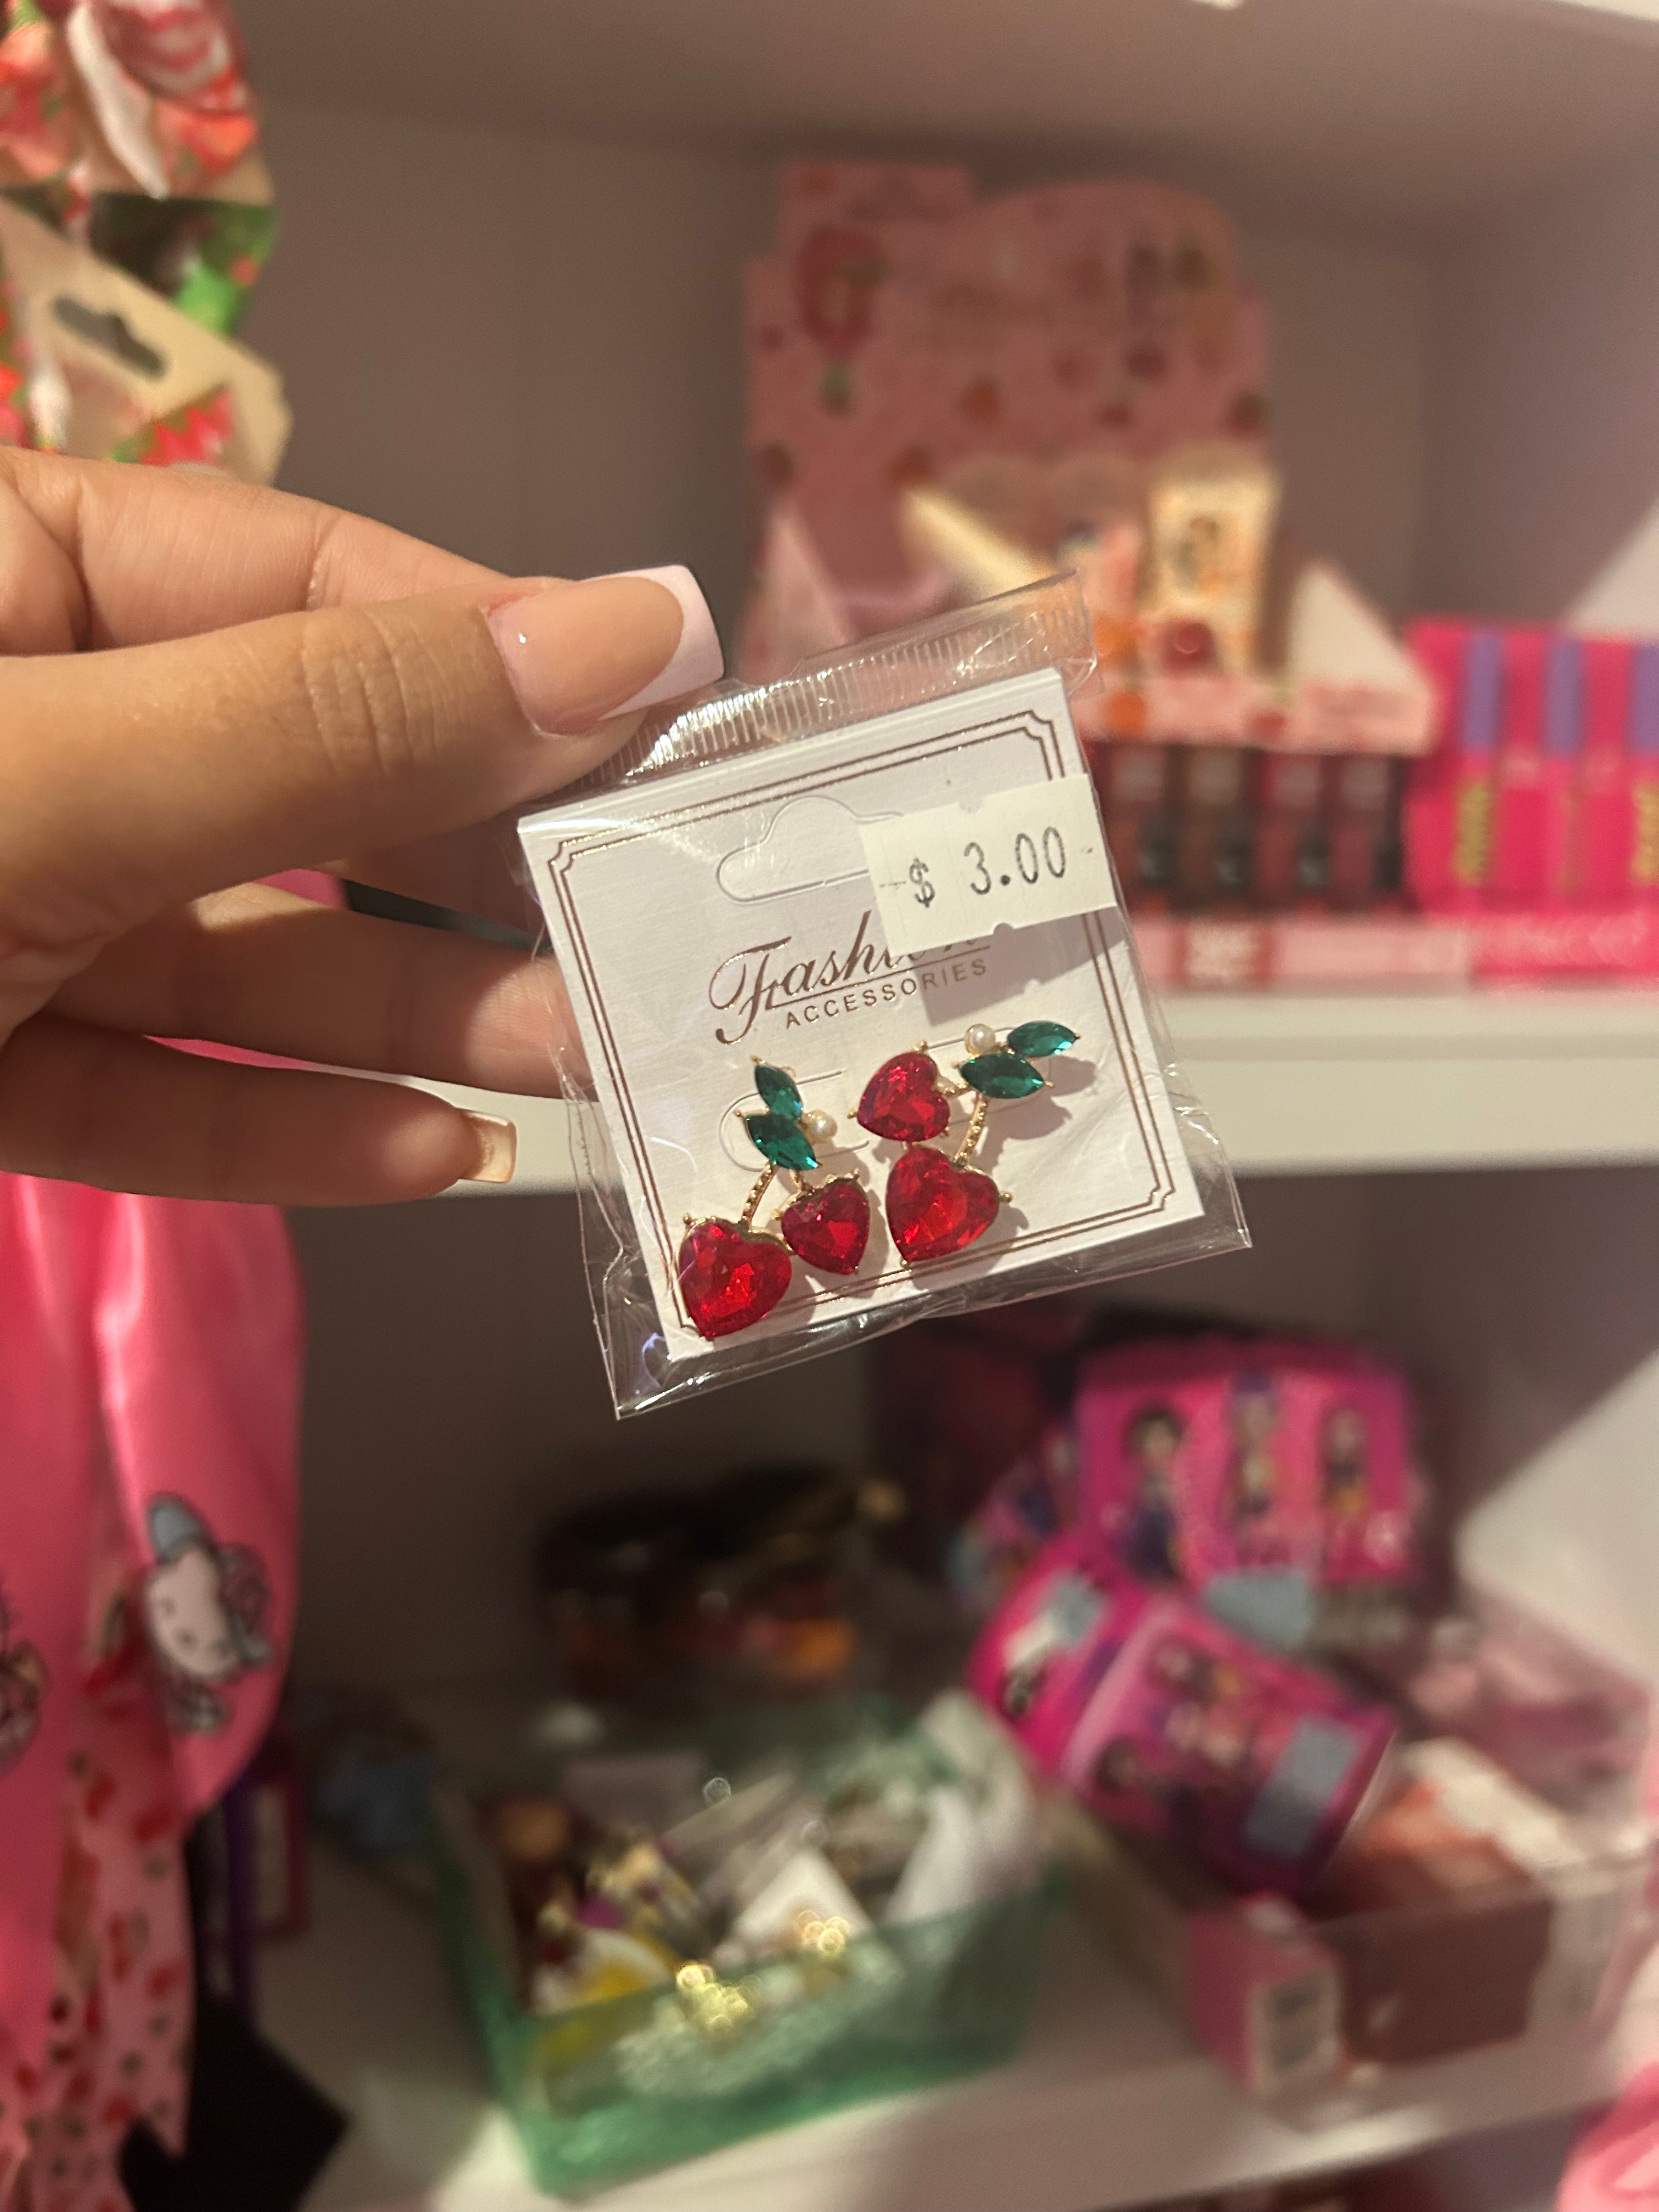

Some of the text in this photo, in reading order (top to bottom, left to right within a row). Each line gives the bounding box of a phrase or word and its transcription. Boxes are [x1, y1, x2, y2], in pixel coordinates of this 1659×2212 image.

[963, 826, 1066, 895] 3.00
[709, 910, 989, 1045] Fashi
[786, 958, 988, 1030] ACCESSORIES
